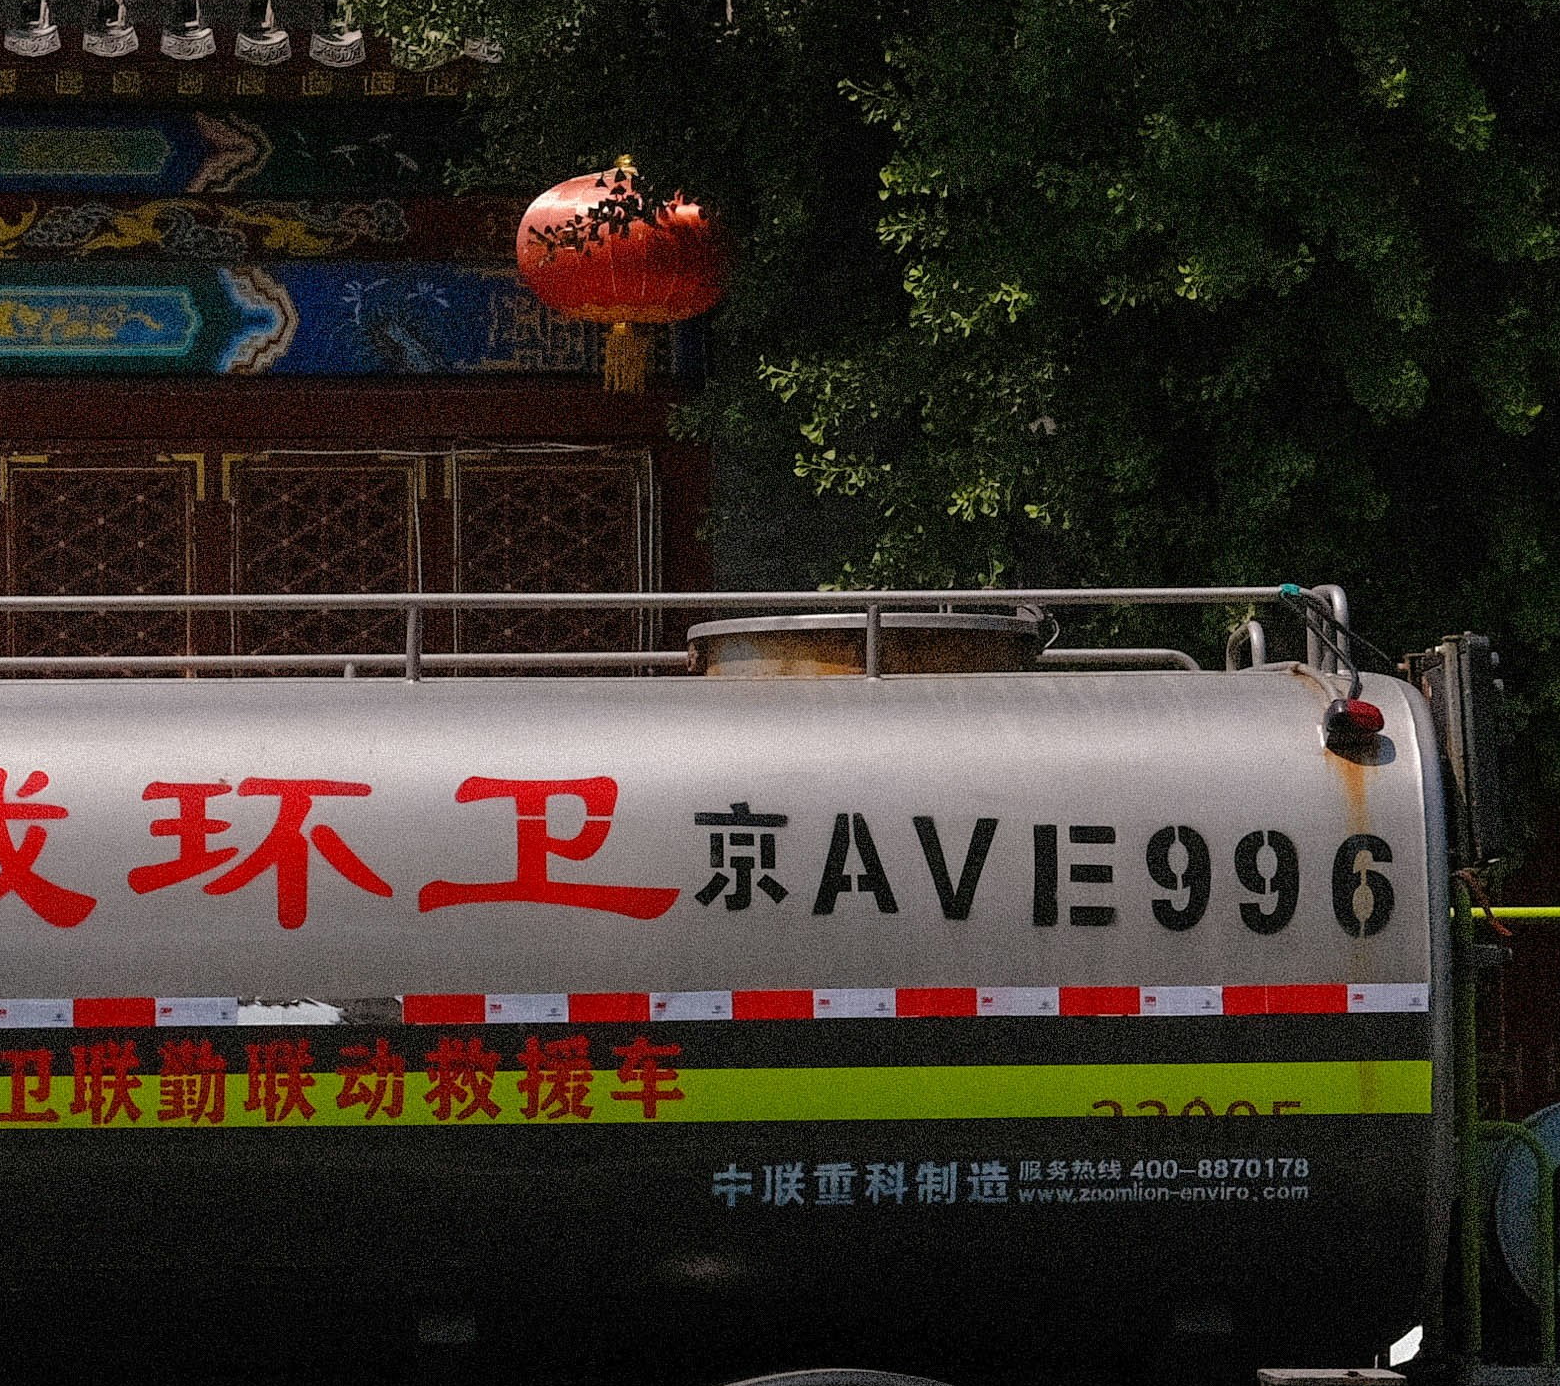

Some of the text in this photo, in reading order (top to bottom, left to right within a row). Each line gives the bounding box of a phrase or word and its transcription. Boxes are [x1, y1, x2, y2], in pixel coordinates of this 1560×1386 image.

[693, 802, 1397, 939] 京AVE996
[711, 1161, 1010, 1209] 中联重科制造
[1017, 1157, 1310, 1182] 服务热线 400-8870178
[1017, 1181, 1310, 1203] www.zoomlion-enviro.com
